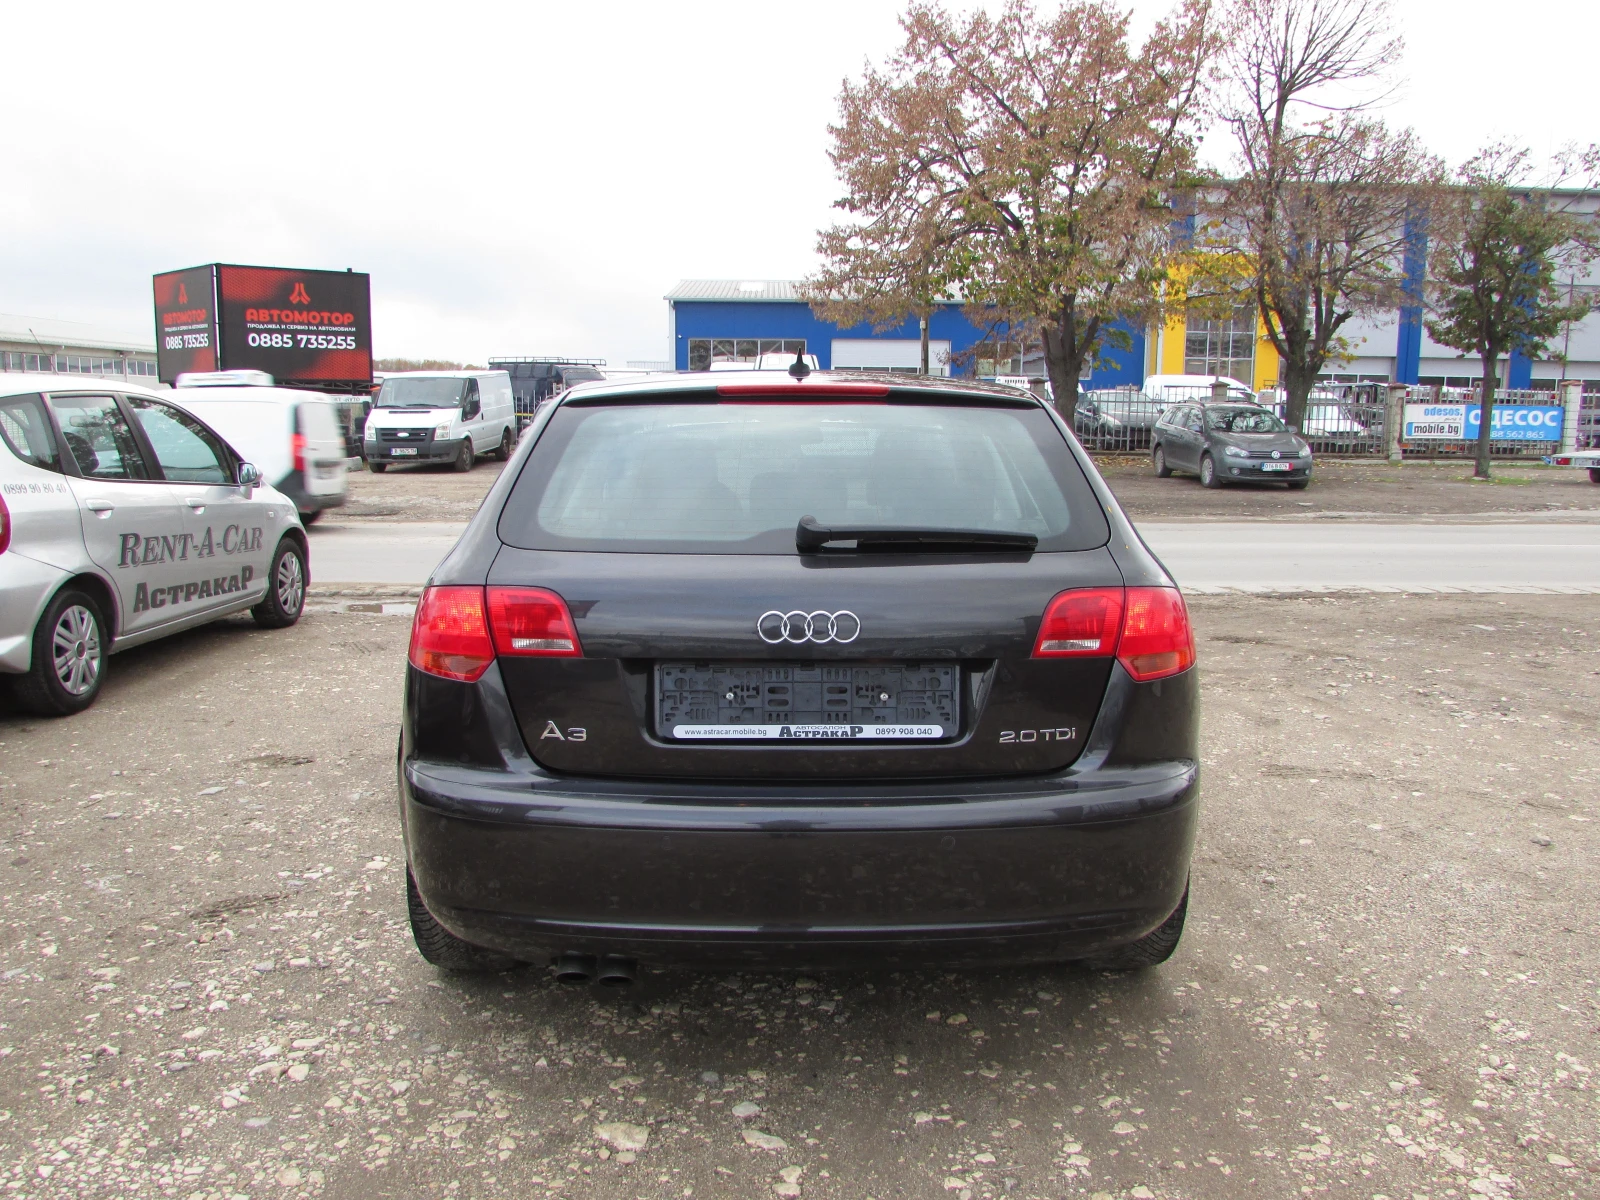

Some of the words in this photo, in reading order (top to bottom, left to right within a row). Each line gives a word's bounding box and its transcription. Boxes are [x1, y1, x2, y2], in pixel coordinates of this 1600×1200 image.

[245, 308, 354, 325] АВТОМОТОР
[165, 336, 183, 349] 0885
[184, 333, 209, 348] 735255
[248, 332, 293, 348] 0885
[297, 334, 356, 350] 735255
[1413, 423, 1459, 435] mobile.bg
[1506, 430, 1524, 438] 562
[1526, 431, 1545, 439] 865
[4, 483, 28, 494] 0899
[29, 483, 41, 494] 90
[42, 483, 54, 493] 80
[56, 483, 67, 493] 40
[133, 565, 254, 613] АСТРАКАР
[540, 720, 587, 741] A3
[684, 728, 767, 737] www.astracar.mobile.bg
[778, 726, 864, 738] АСТРАКАР
